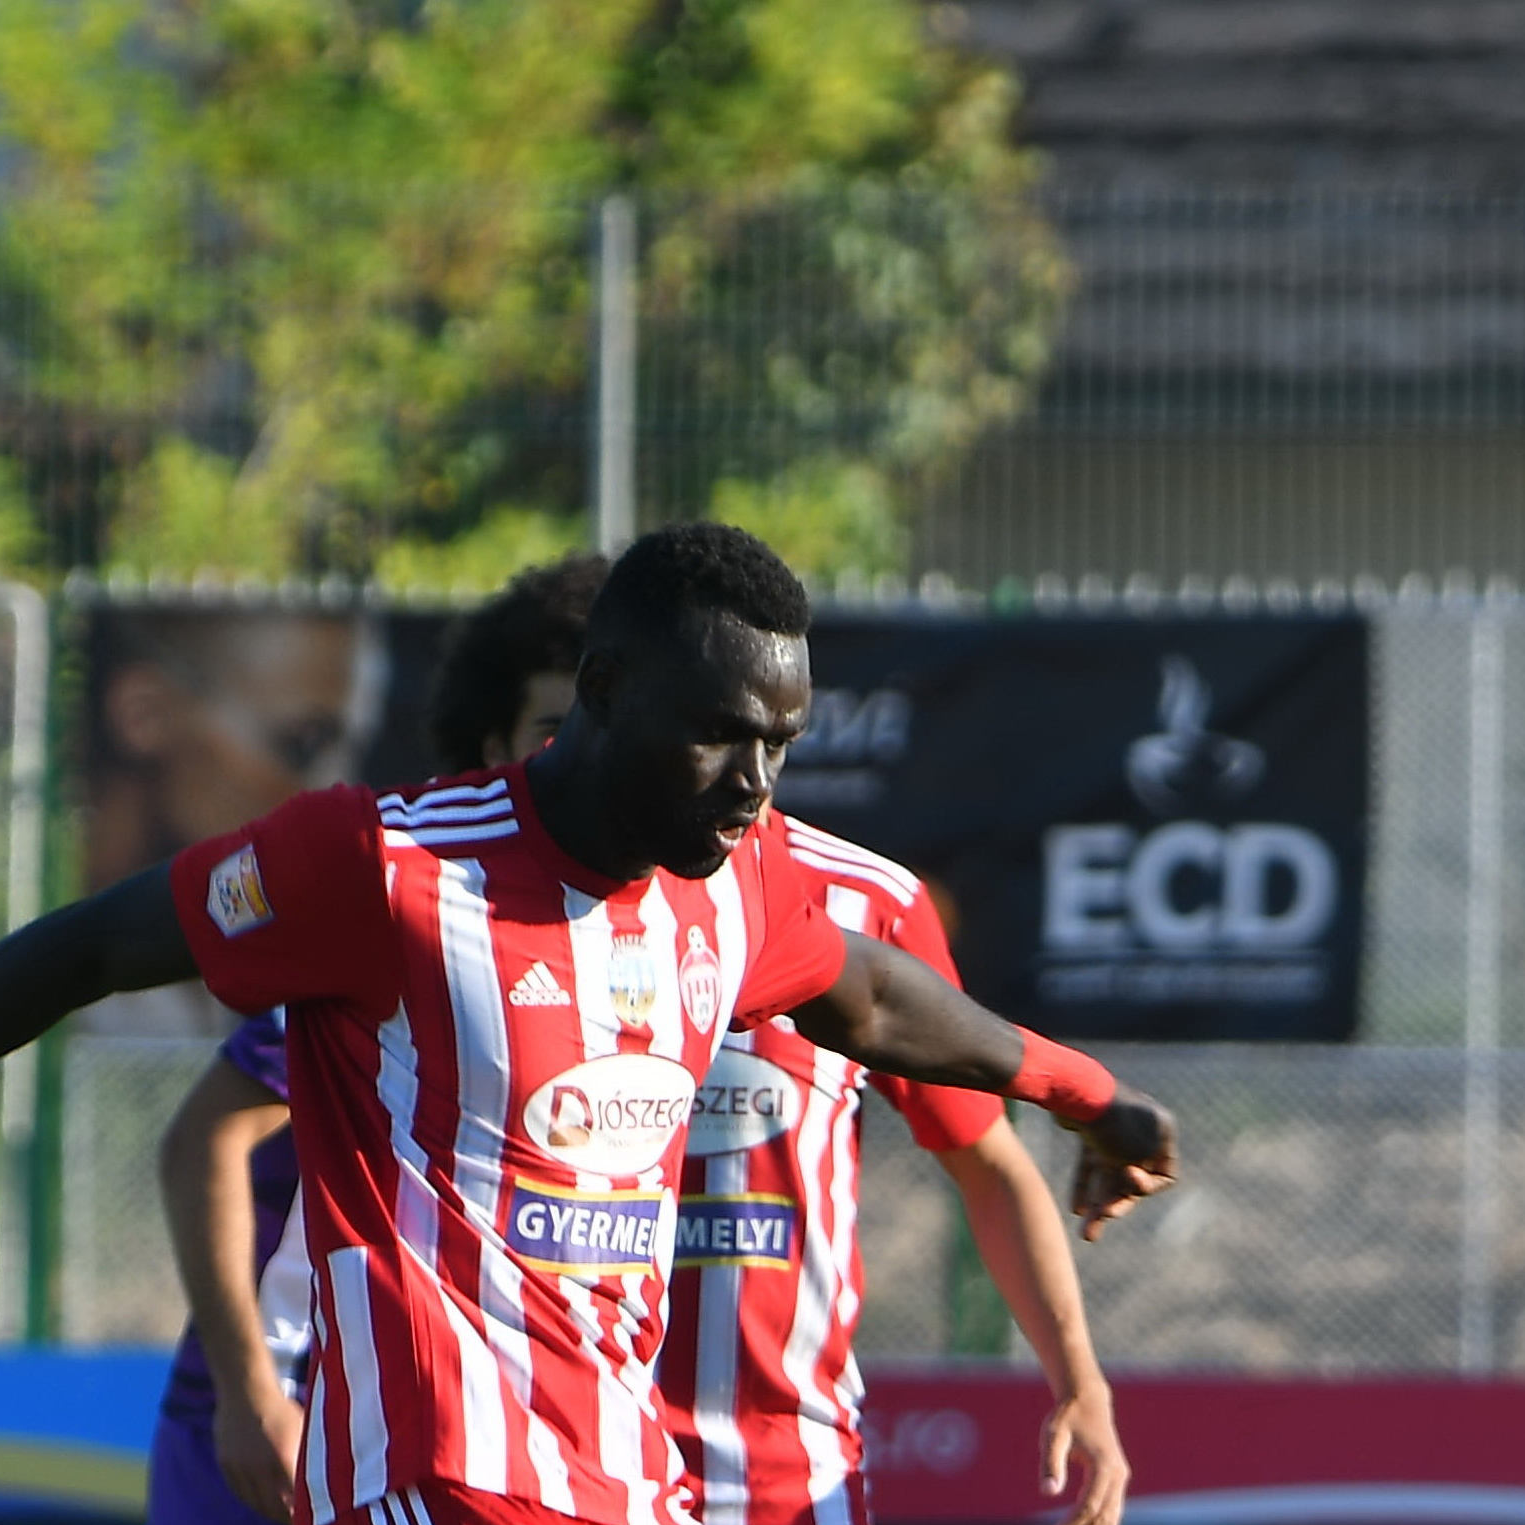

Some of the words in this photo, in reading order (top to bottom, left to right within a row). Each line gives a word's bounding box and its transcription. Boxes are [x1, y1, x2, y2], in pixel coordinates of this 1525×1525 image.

[1043, 822, 1339, 950] ECD
[692, 1087, 784, 1118] SZEGI
[677, 1217, 786, 1251] MELYI
